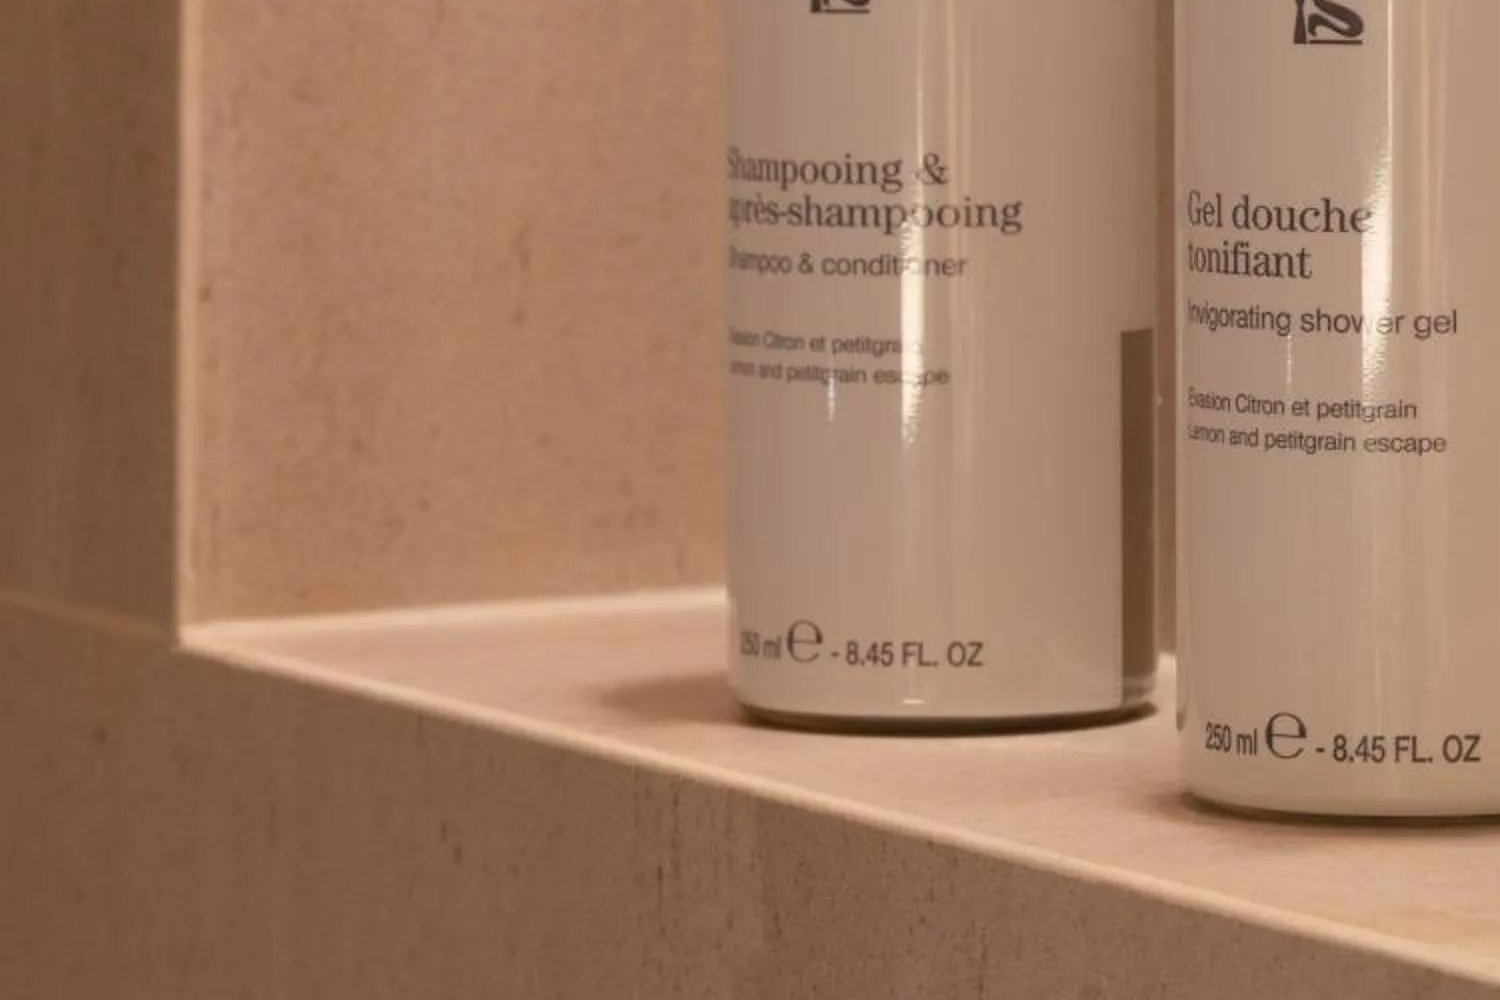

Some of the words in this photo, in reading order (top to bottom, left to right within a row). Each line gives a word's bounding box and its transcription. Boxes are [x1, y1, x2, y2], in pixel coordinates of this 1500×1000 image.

[914, 151, 948, 185] &
[1187, 189, 1223, 228] Gel
[1232, 194, 1373, 234] douche
[798, 252, 814, 275] &
[821, 255, 968, 278] conditoner
[1187, 239, 1313, 280] tonifiant
[1187, 298, 1292, 337] Invigorating
[1413, 310, 1458, 338] gel
[873, 370, 950, 388] escpe
[1235, 393, 1285, 415] Citron
[1291, 400, 1310, 416] et
[1317, 400, 1417, 423] petitgrain
[1229, 428, 1259, 448] and
[1264, 430, 1355, 454] petitgrain
[1363, 435, 1447, 456] escape
[845, 640, 894, 667] 8.45
[901, 641, 939, 667] FL.
[947, 641, 983, 667] OZ
[1205, 721, 1231, 753] 250
[1236, 729, 1257, 756] ml
[1332, 735, 1385, 762] 8.45
[1395, 736, 1433, 763] FL.
[1443, 735, 1481, 763] OZ
